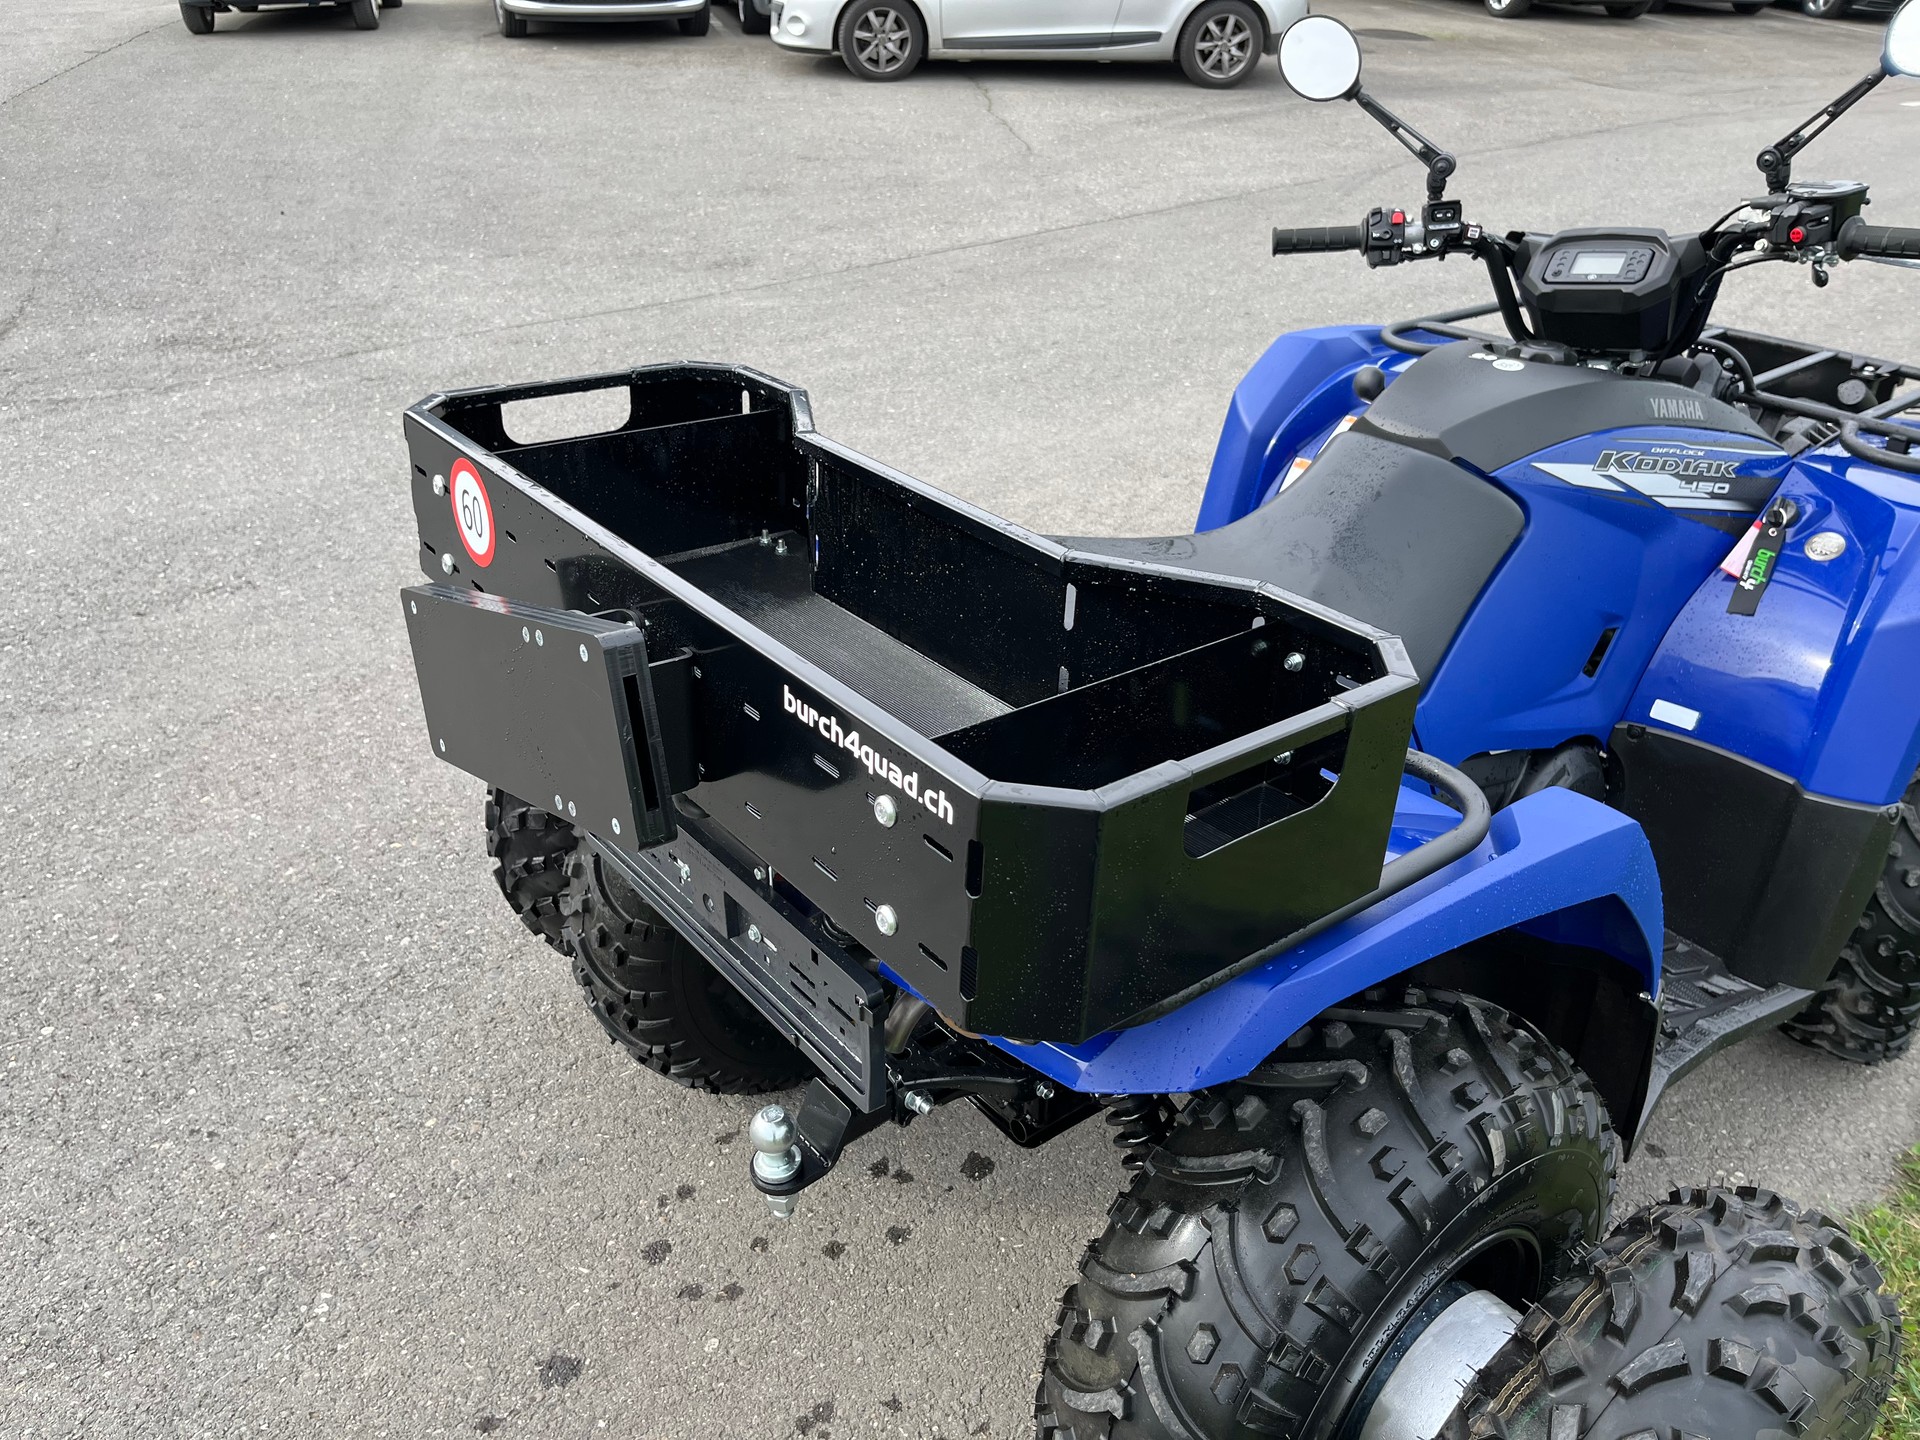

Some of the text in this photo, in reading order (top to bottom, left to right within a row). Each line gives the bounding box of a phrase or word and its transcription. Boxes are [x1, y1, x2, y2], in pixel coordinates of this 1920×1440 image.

[1650, 398, 1704, 420] YAMAHA
[1592, 450, 1739, 478] KODIAK
[1651, 447, 1705, 456] DIFFLOCK
[1679, 480, 1730, 494] 450
[462, 488, 483, 538] 60
[783, 684, 954, 825] burch4quad.ch
